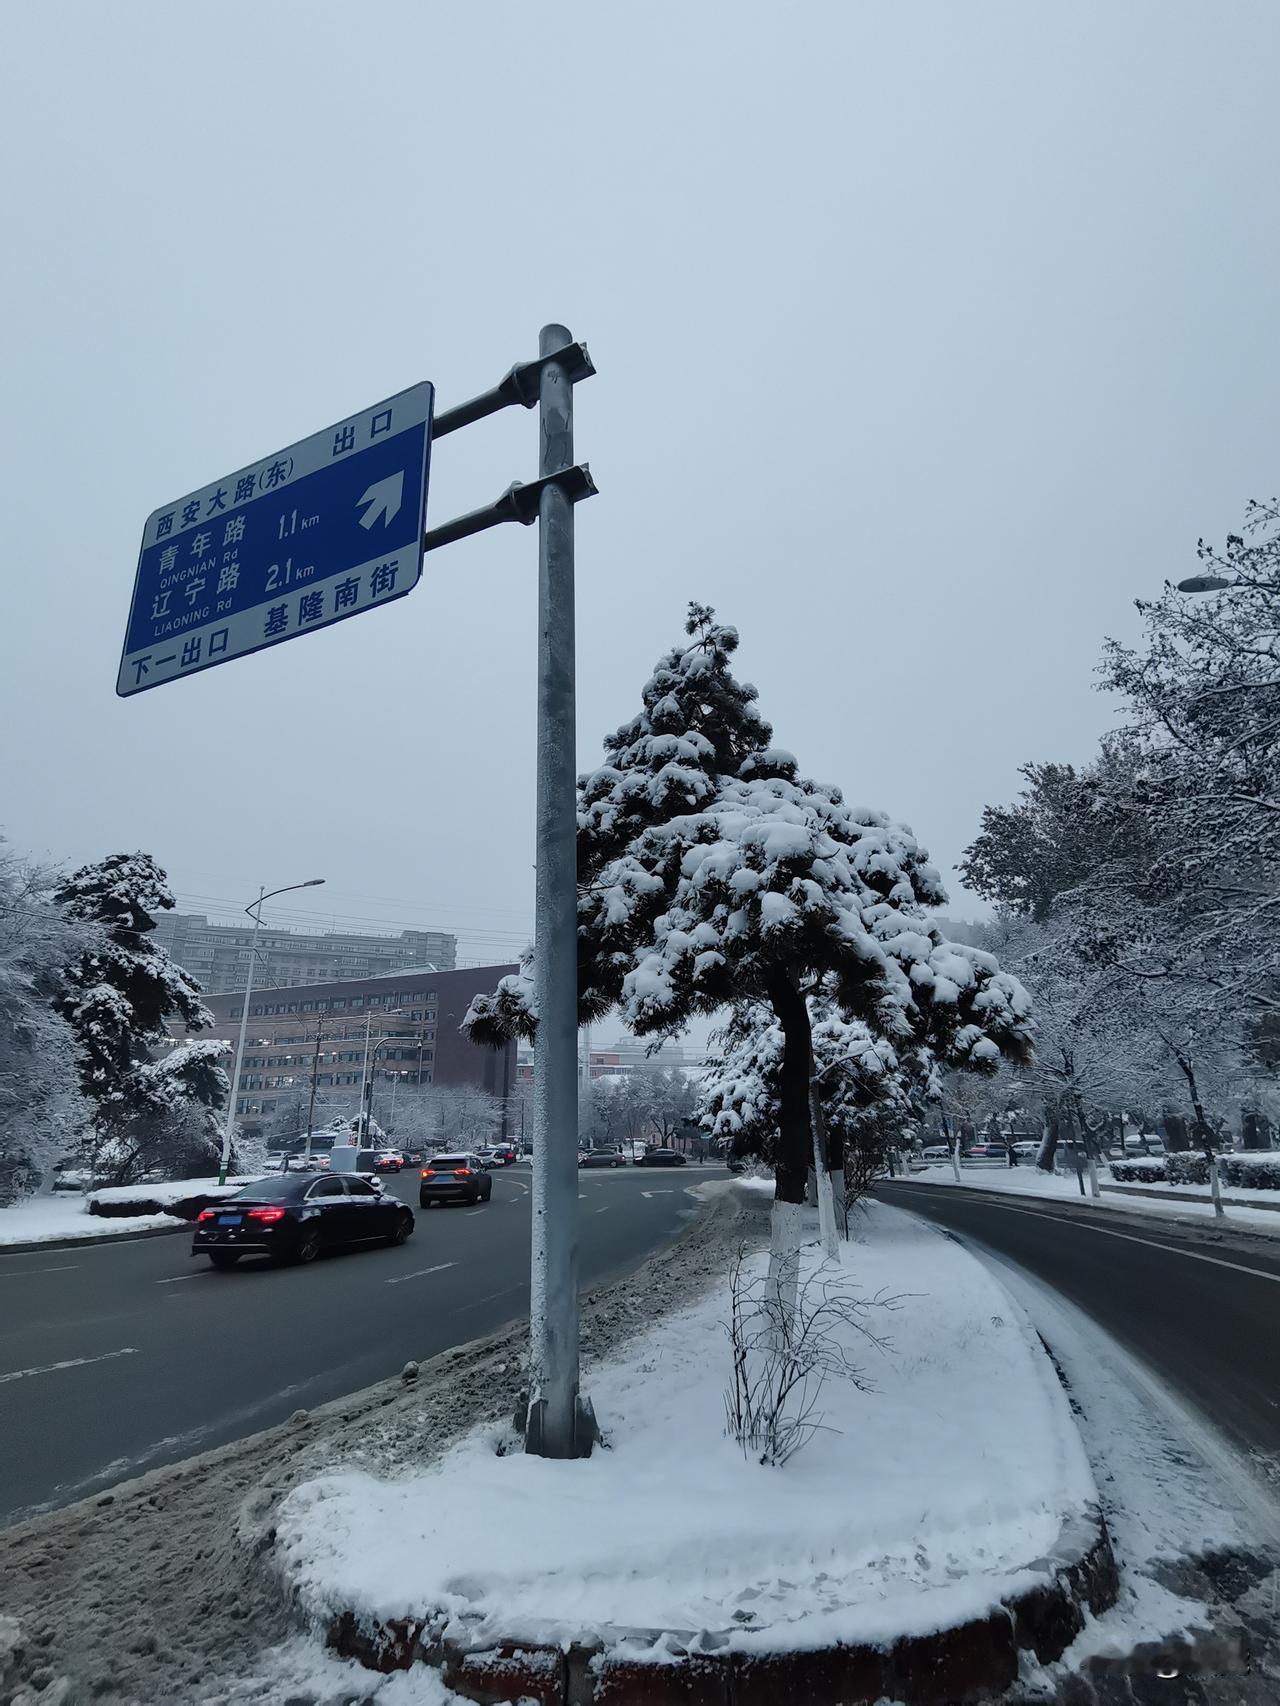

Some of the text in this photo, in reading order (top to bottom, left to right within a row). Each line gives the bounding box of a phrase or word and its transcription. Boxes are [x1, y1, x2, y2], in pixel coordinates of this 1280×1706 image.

[332, 408, 393, 457] 出口
[158, 515, 247, 575] 青年路
[223, 549, 238, 564] Rd
[150, 562, 241, 621] 辽宁路
[154, 597, 232, 637] LIAONING Rd
[131, 560, 399, 684] 下一出口 基隆南街
